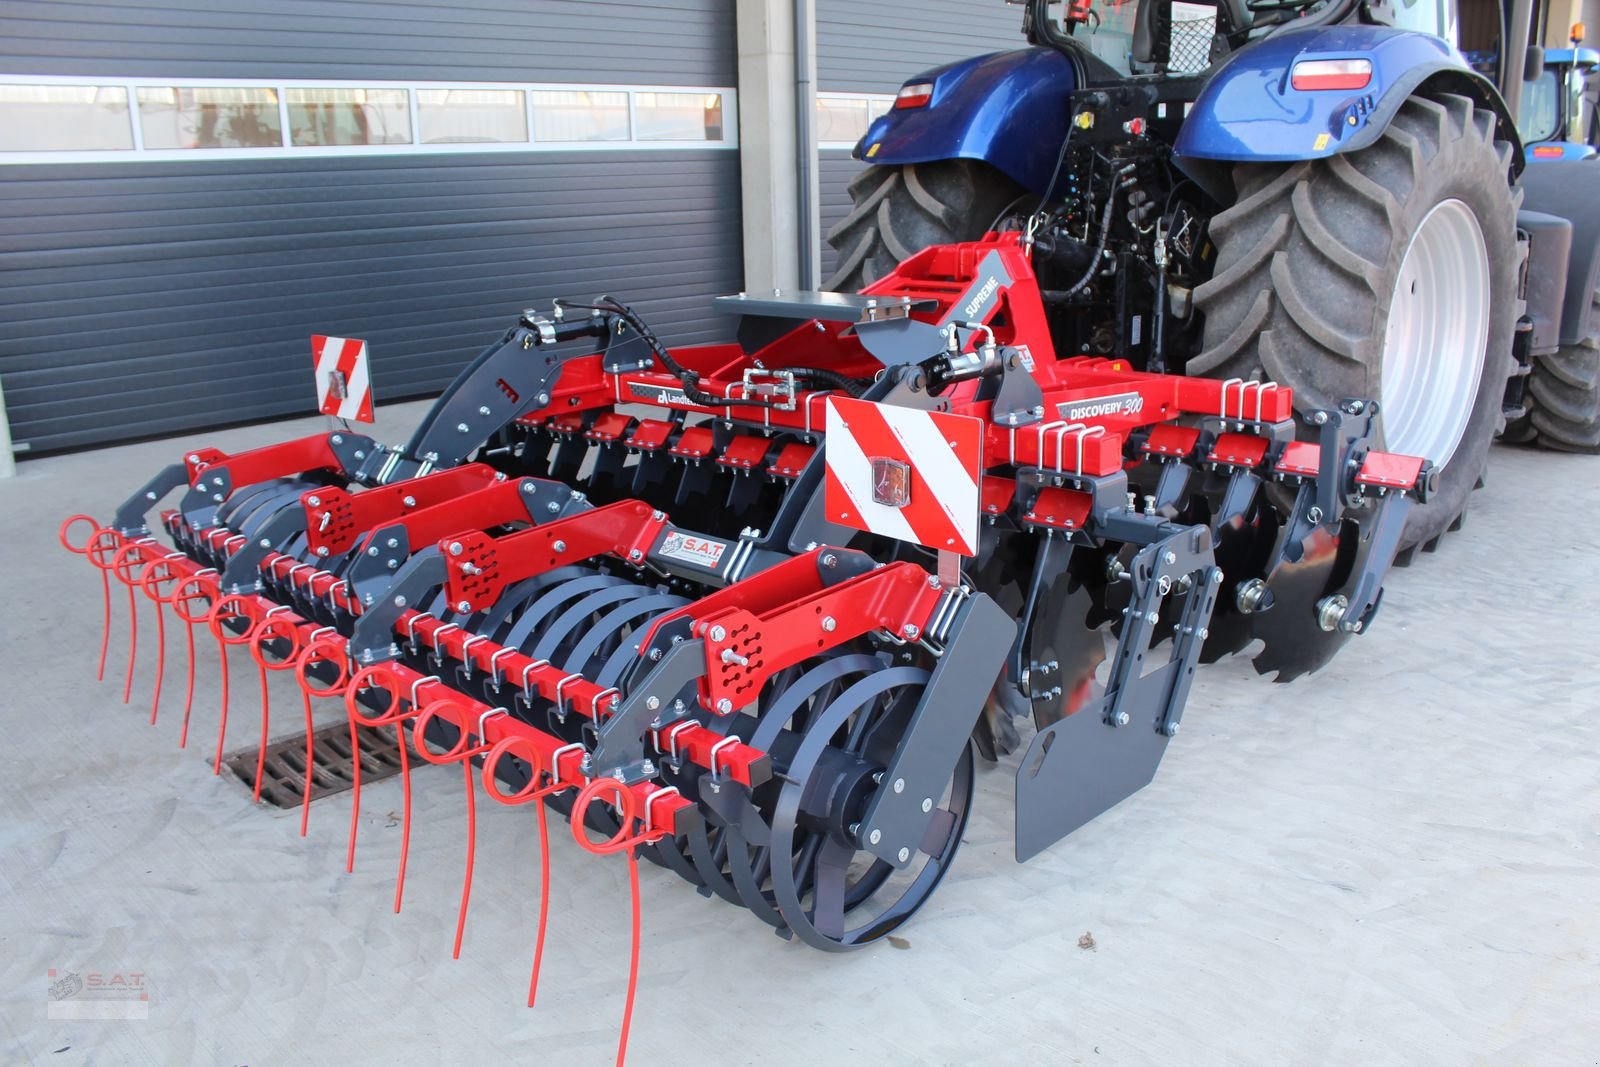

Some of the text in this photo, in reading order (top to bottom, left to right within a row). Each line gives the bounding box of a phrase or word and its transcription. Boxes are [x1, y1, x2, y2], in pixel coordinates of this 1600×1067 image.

[965, 276, 999, 318] SUPREME
[1070, 396, 1144, 420] DISCOVERY 300
[683, 537, 723, 556] S.A.T.
